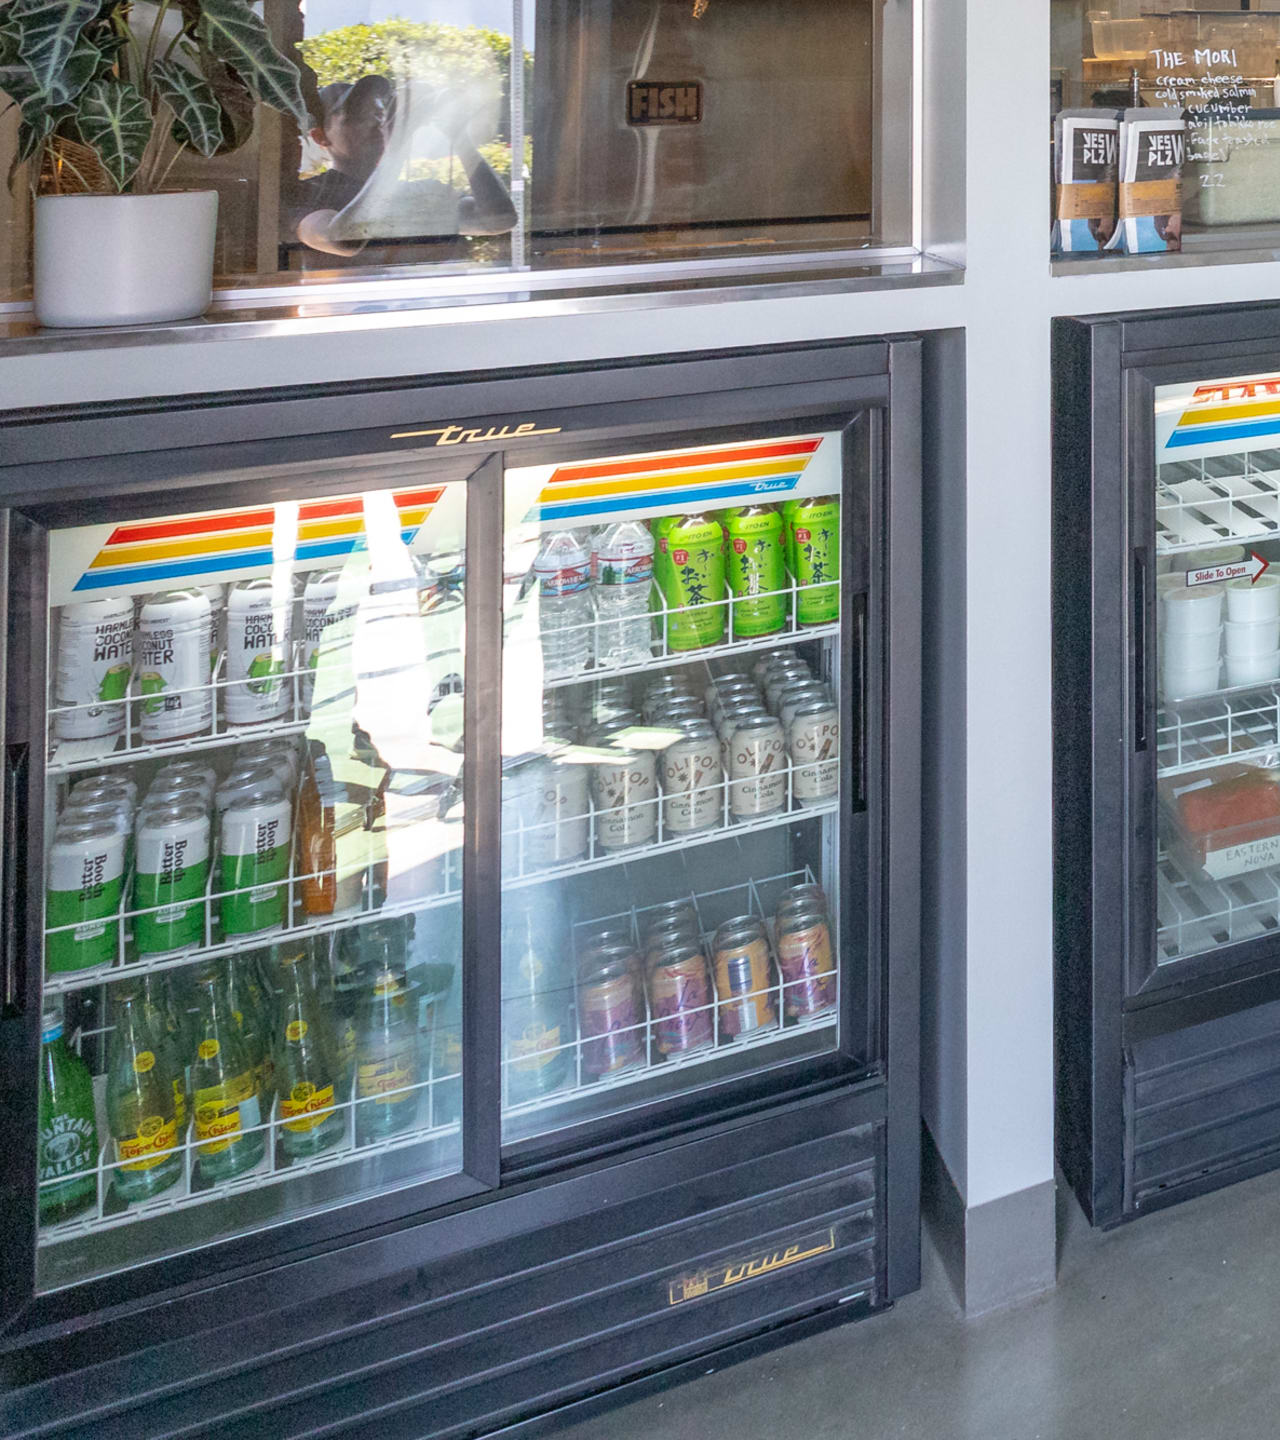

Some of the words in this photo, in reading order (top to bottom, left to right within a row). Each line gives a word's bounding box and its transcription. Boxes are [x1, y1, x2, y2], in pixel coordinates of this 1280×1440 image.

[1149, 48, 1187, 69] THE
[1194, 48, 1237, 68] MORI
[1156, 74, 1195, 87] cream
[1201, 72, 1243, 86] cheese
[632, 87, 697, 118] FISH
[1155, 88, 1177, 101] cold
[1188, 103, 1252, 115] cucumber
[1083, 133, 1105, 148] YES
[1148, 134, 1171, 150] YES
[1083, 149, 1105, 164] PLZ
[1148, 151, 1173, 166] PLZ
[1194, 569, 1213, 583] Slide
[1215, 567, 1225, 580] To
[1226, 564, 1246, 579] Open
[267, 819, 279, 862] Booch
[1226, 840, 1280, 861] EASTERN
[160, 844, 174, 886] Better
[174, 839, 188, 883] Booch
[1244, 853, 1275, 867] NOVA
[94, 853, 108, 899] Booch
